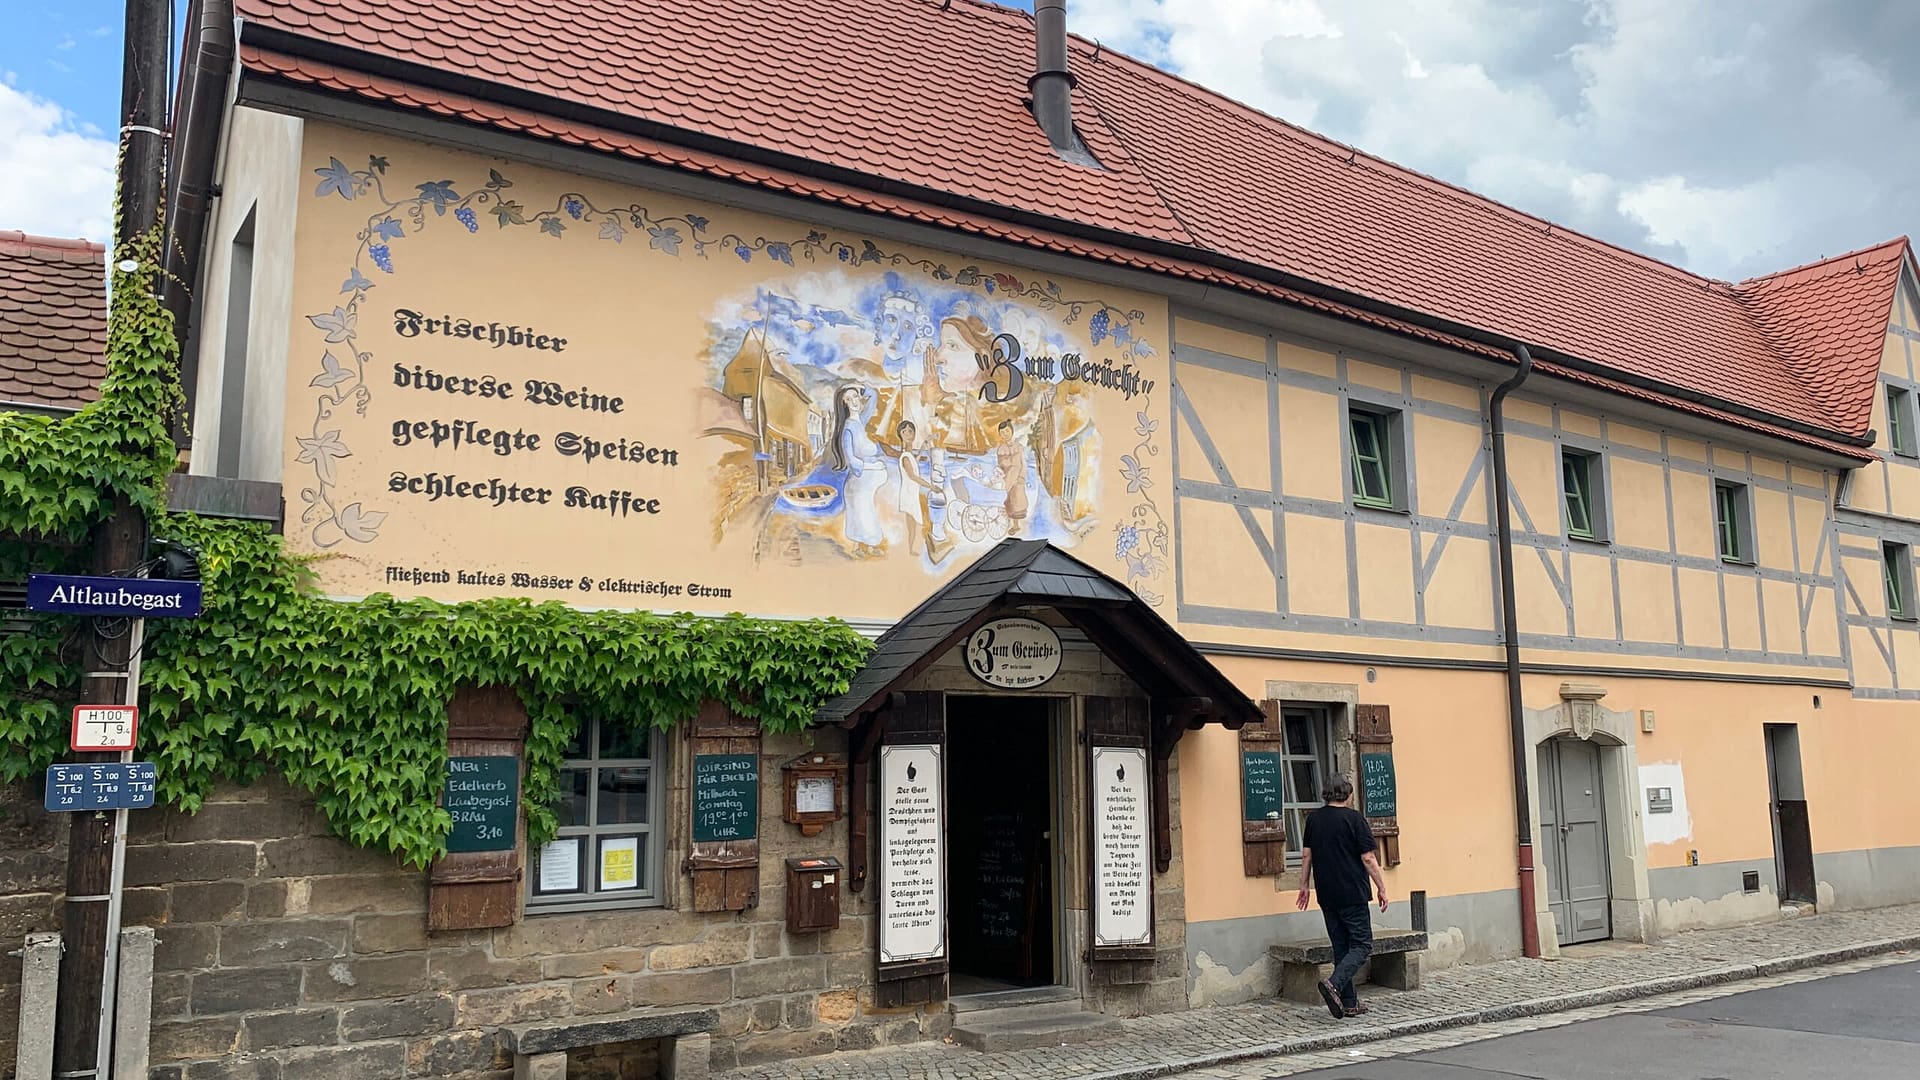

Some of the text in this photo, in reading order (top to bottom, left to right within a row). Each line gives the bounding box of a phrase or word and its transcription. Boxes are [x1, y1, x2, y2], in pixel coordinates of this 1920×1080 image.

[393, 308, 568, 352] Frischbier
[393, 363, 625, 414] diverse Weine
[392, 419, 679, 466] gepflegte Speisen
[388, 471, 661, 518] schlechter Kaffee
[386, 566, 732, 599] fließend kaltes Wasser & elektrischer Strom
[48, 585, 182, 610] Altlaubegast
[101, 735, 116, 746] 2.0
[57, 770, 66, 780] S
[94, 770, 102, 780] S
[129, 768, 137, 779] S
[450, 780, 506, 791] Edelherb
[448, 794, 512, 810] Laubegast
[698, 800, 743, 811] Sonntag
[714, 826, 740, 837] UHR
